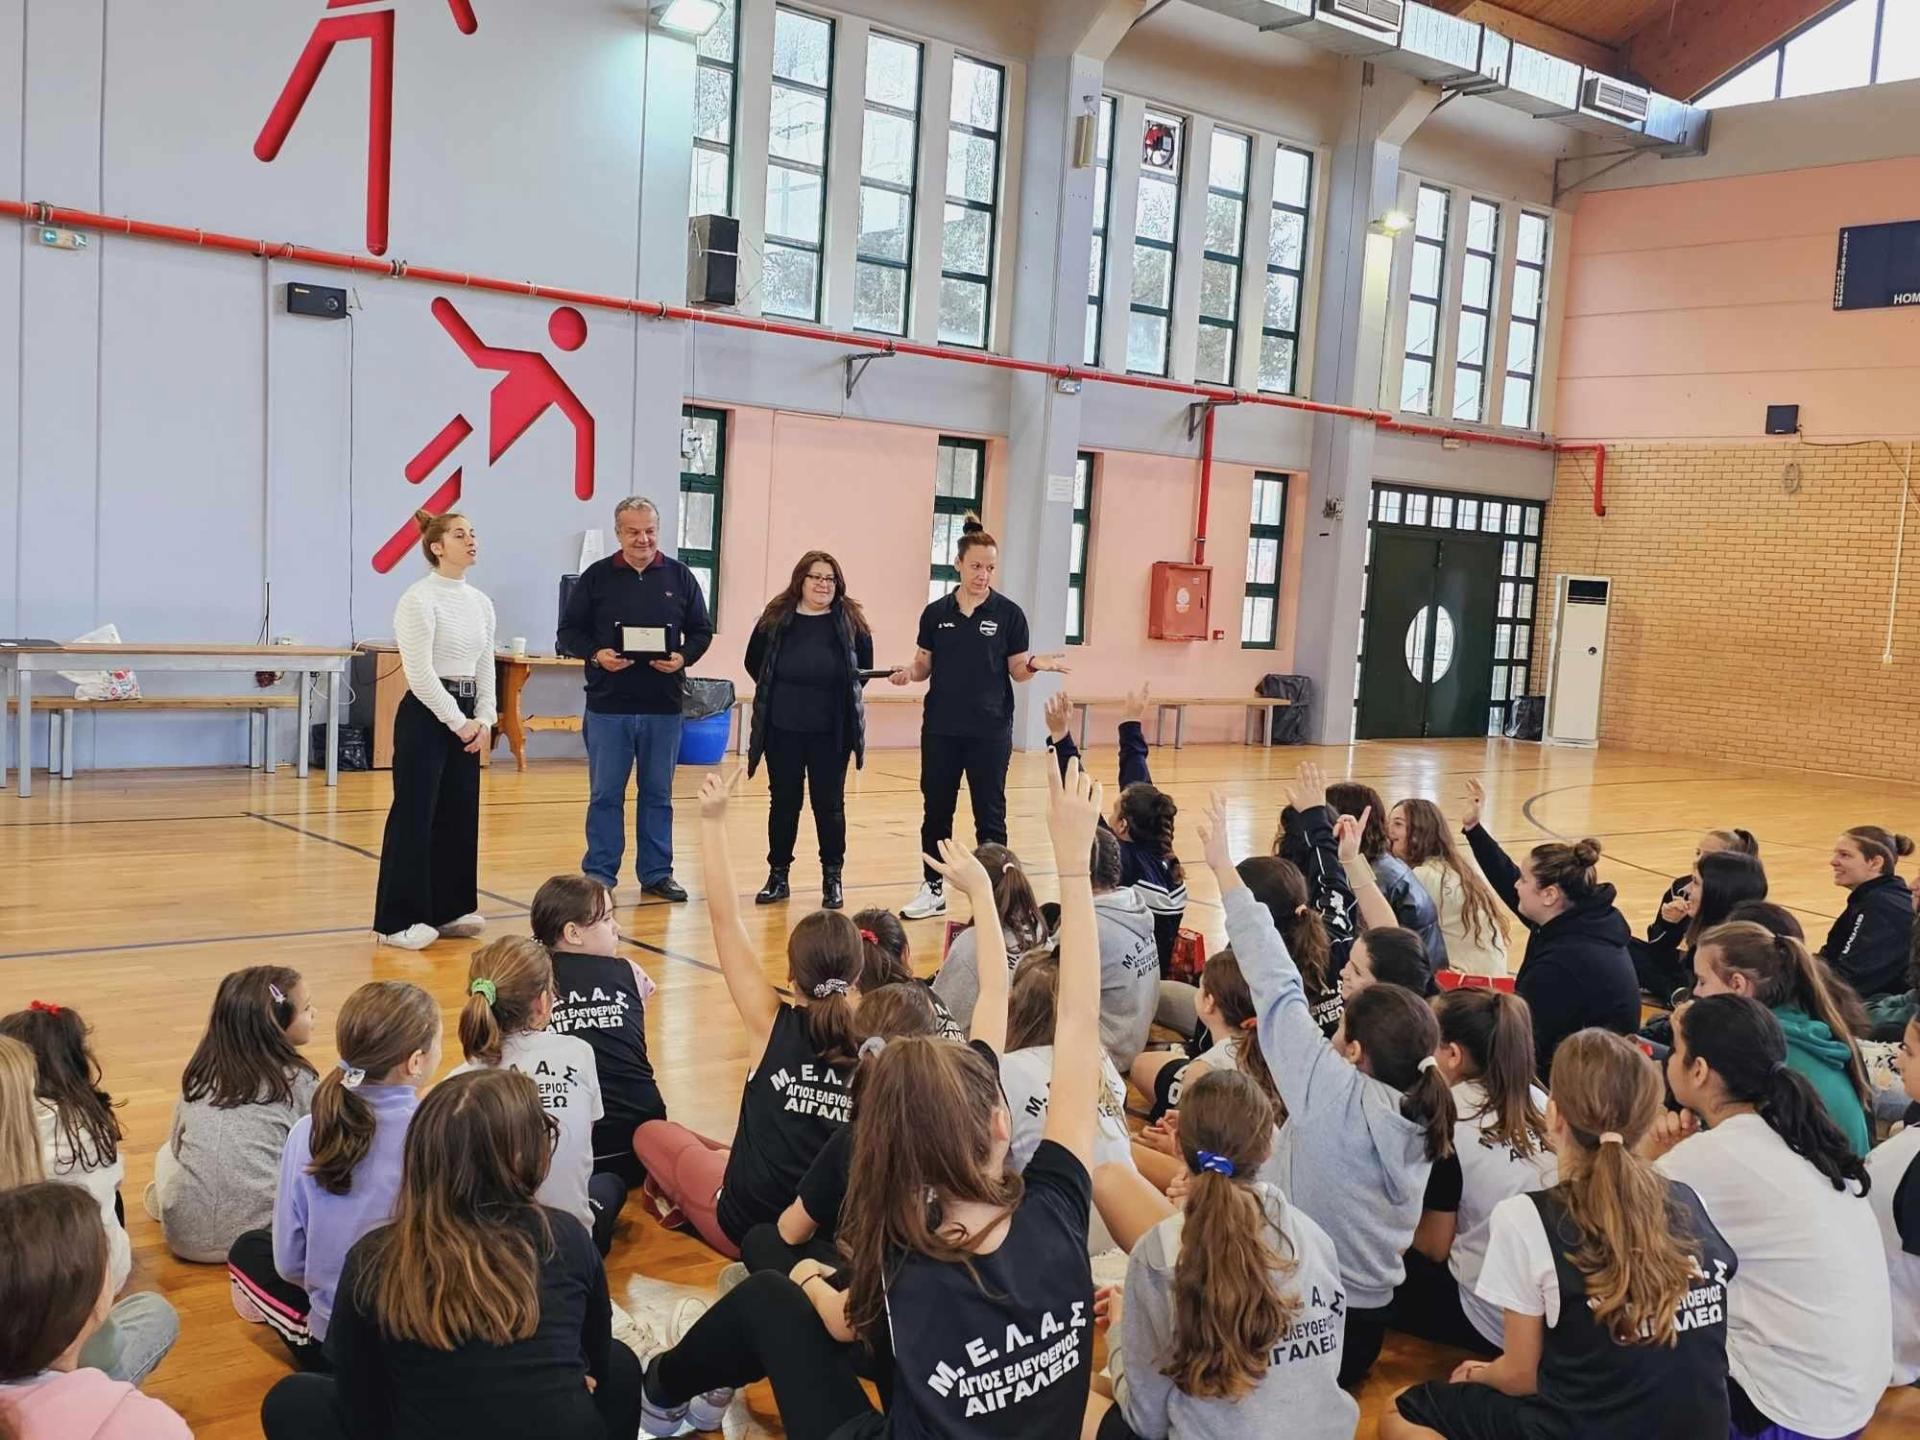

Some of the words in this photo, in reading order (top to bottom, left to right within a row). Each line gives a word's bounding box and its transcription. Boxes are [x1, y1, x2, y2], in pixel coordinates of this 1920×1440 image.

[784, 1097, 852, 1123] ΑΙΓΑΛΕ
[786, 1083, 815, 1100] ΑΓΙΟΣ
[816, 1090, 854, 1109] ΕΛΕΥΘΕ
[959, 1370, 1004, 1398] ΑΓΙΟΣ
[1004, 1328, 1080, 1384] ΕΛΕΥΘΕΡΙΟΣ
[965, 1350, 1080, 1418] ΑΙΓΑΛΕΩ
